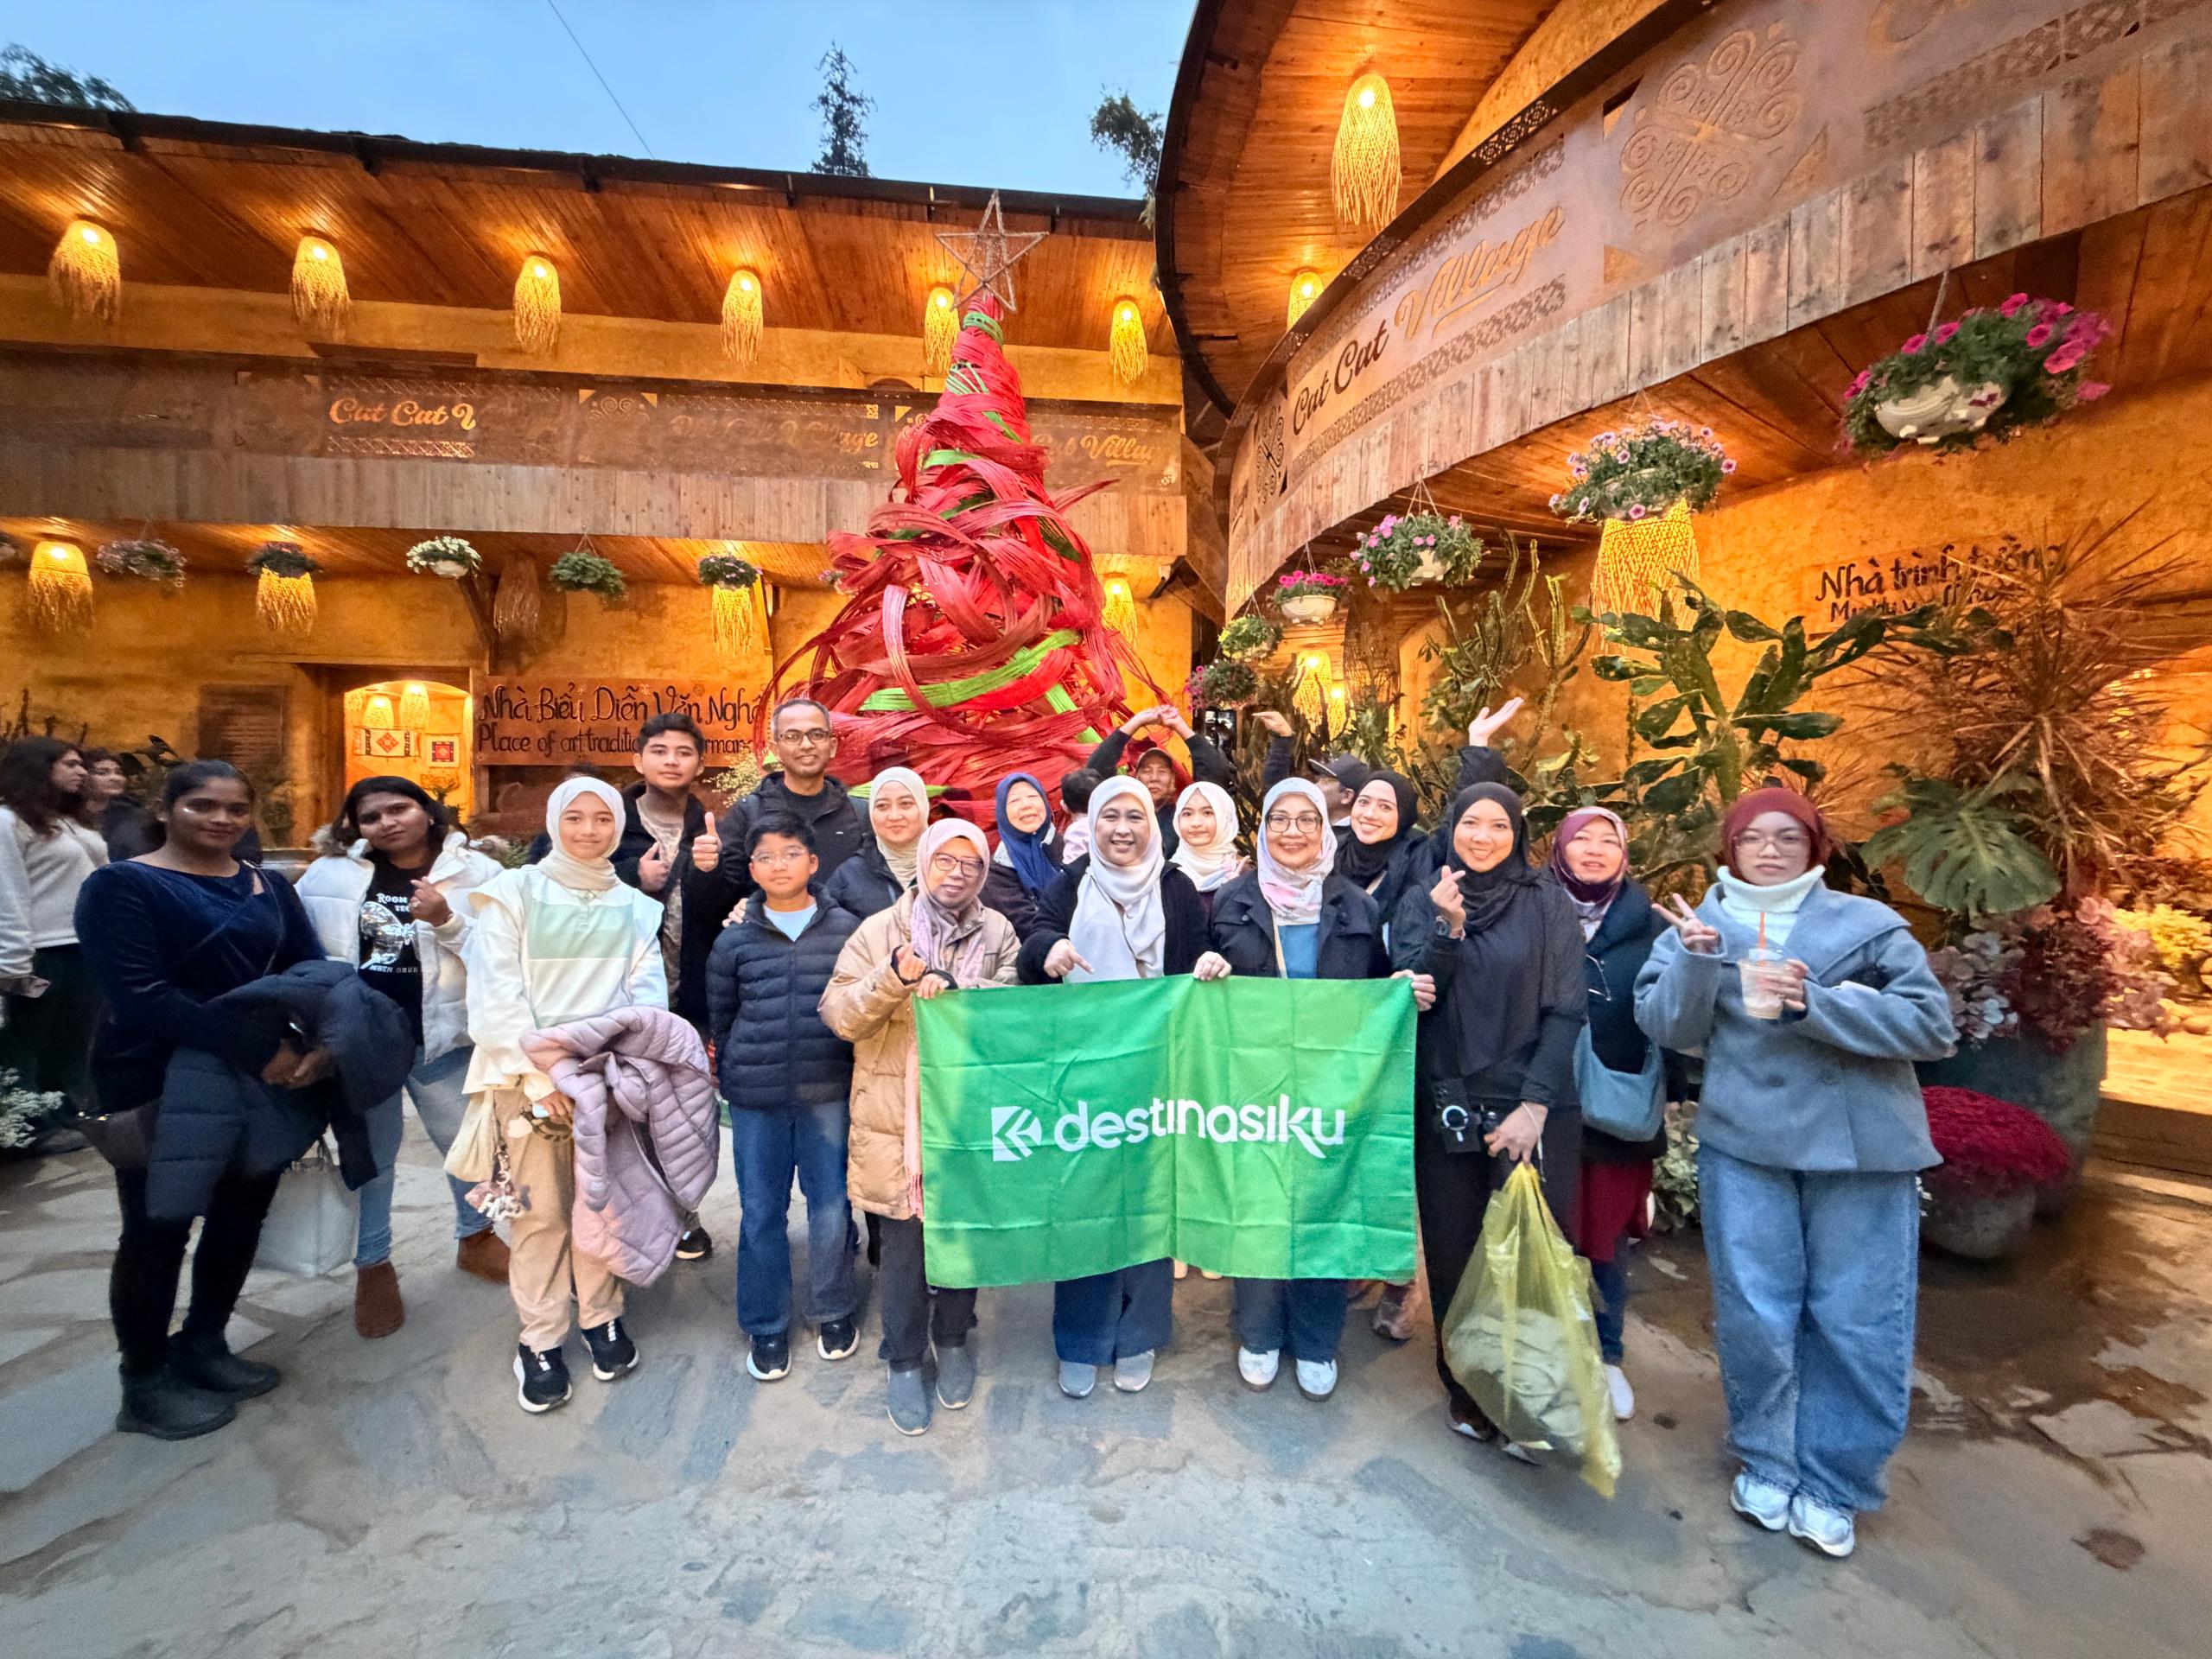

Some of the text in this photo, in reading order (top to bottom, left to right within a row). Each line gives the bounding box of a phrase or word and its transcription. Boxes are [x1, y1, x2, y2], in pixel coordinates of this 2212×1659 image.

[1293, 206, 1566, 435] Cat Cat Village
[329, 397, 386, 423] Cat
[391, 400, 448, 426] Cat
[1815, 557, 1884, 601] Nhà
[478, 684, 531, 721] Nhà
[590, 685, 648, 721] Diễn
[477, 722, 531, 753] Place
[537, 730, 556, 758] of
[1053, 1093, 1345, 1160] destinasiku
